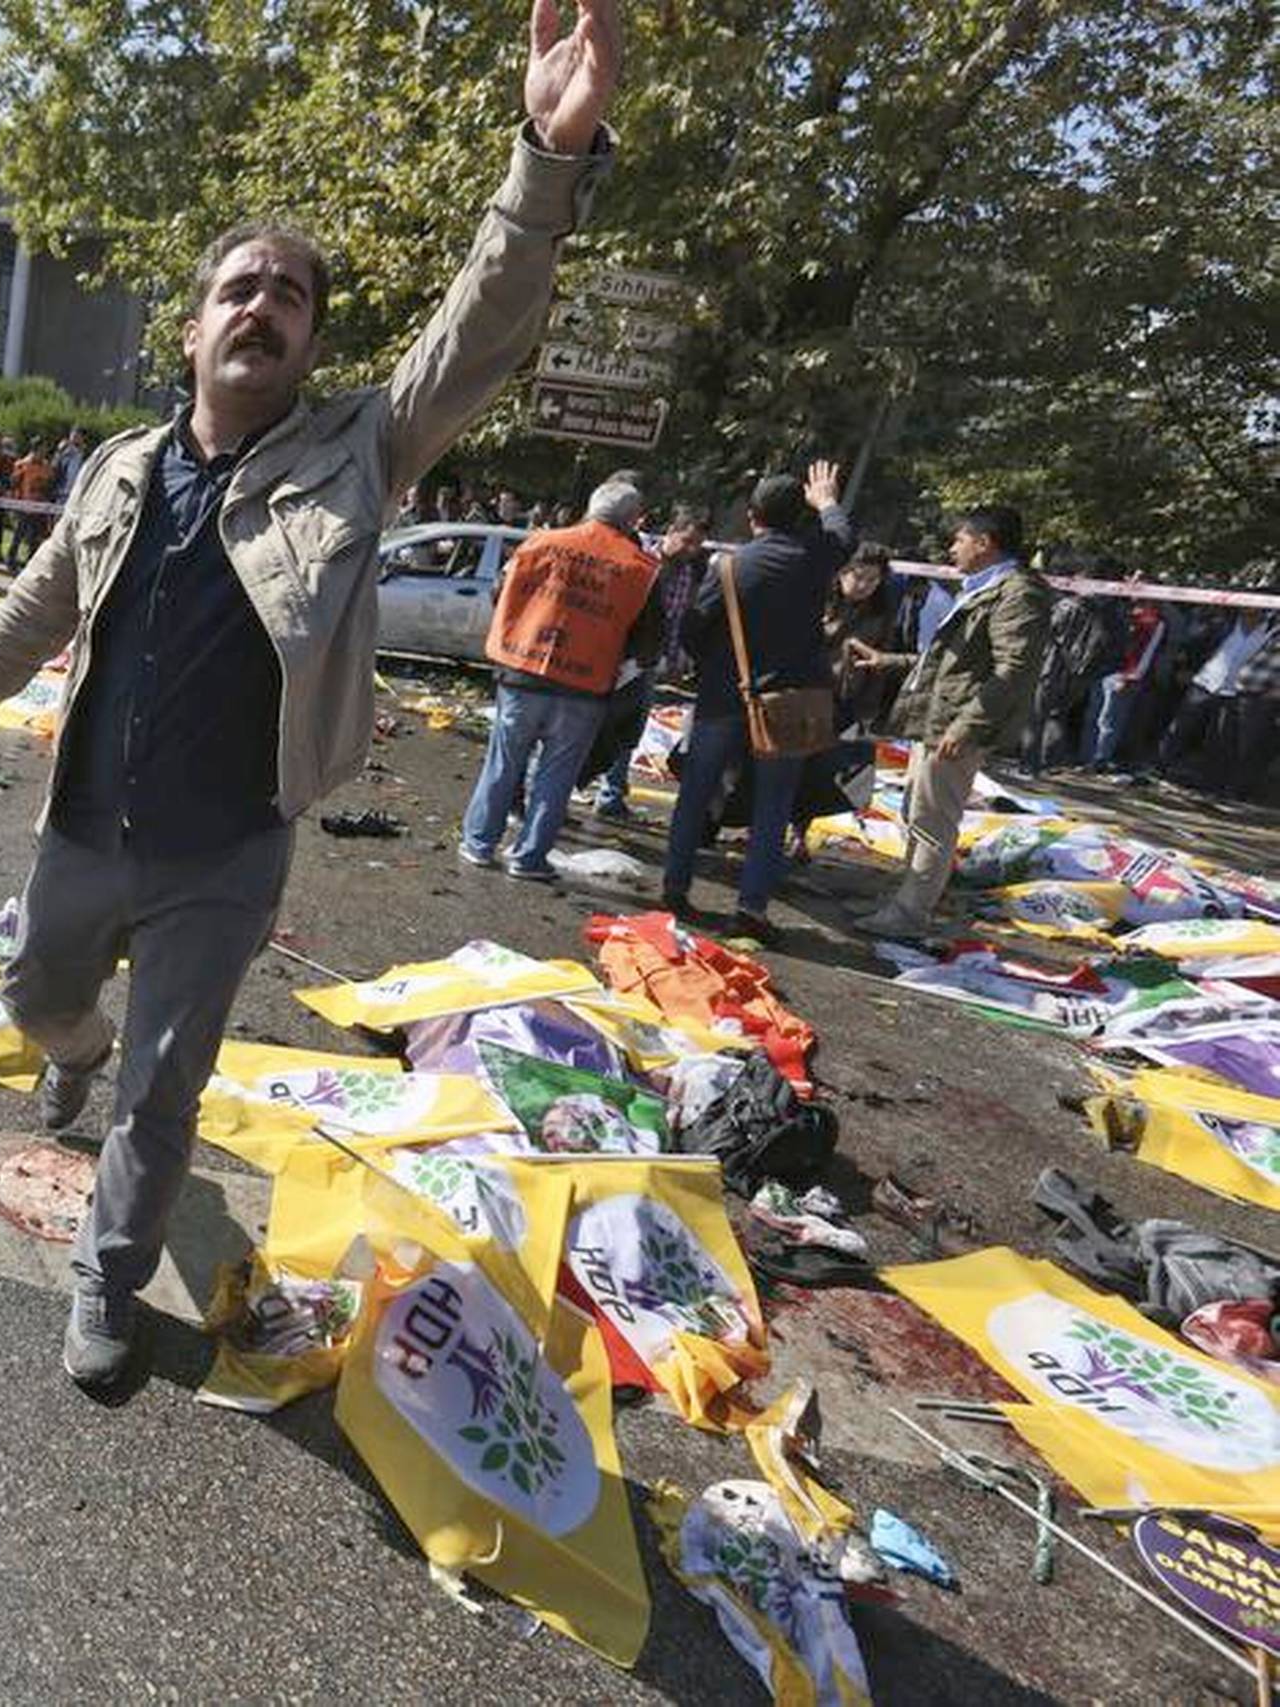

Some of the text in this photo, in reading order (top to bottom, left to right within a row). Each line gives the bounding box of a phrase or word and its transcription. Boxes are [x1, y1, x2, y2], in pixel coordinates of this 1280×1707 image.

[571, 1246, 636, 1324] HDP
[392, 1278, 463, 1379] HDP
[1027, 1351, 1127, 1412] HDP
[1156, 1511, 1280, 1583] SARA
